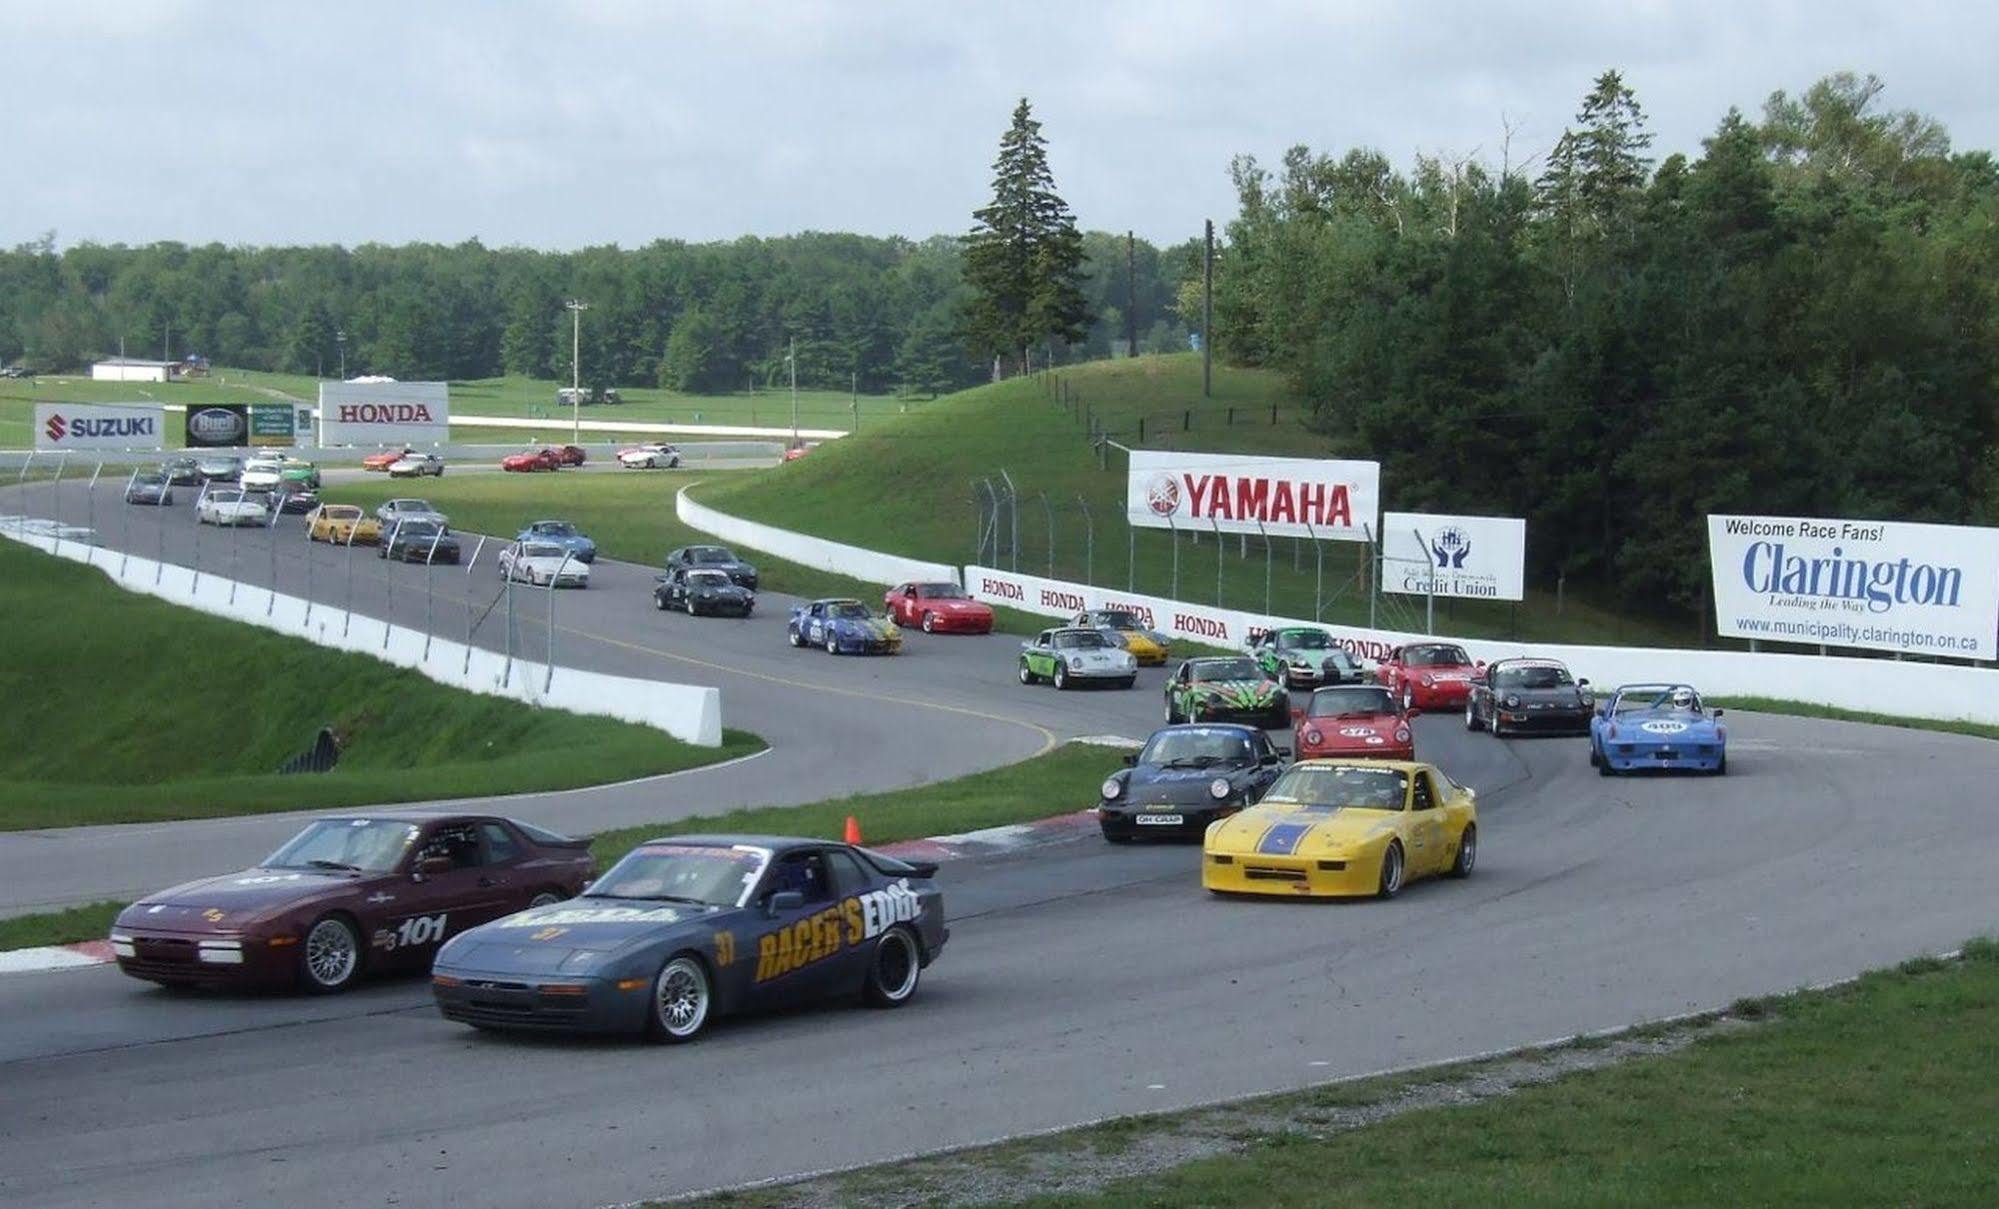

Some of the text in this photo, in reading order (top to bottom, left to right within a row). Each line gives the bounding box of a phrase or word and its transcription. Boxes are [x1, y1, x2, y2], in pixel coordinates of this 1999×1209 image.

[339, 404, 433, 423] HONDA
[71, 416, 154, 438] SUZUKI
[1183, 473, 1352, 527] YAMAHA
[1725, 519, 1885, 542] Welcome Race Fans!
[1403, 576, 1449, 594] Credit
[1454, 579, 1497, 597] Union
[1743, 540, 1963, 614] Clarington
[982, 578, 1025, 601] HONDA
[1040, 589, 1086, 612] HONDA
[1769, 595, 1865, 613] Leading the Way
[1174, 613, 1229, 640] HONDA
[1735, 618, 1979, 651] www.municipality.clarington.on.ca
[398, 912, 448, 947] 101
[756, 877, 922, 984] RACER'S EDGE
